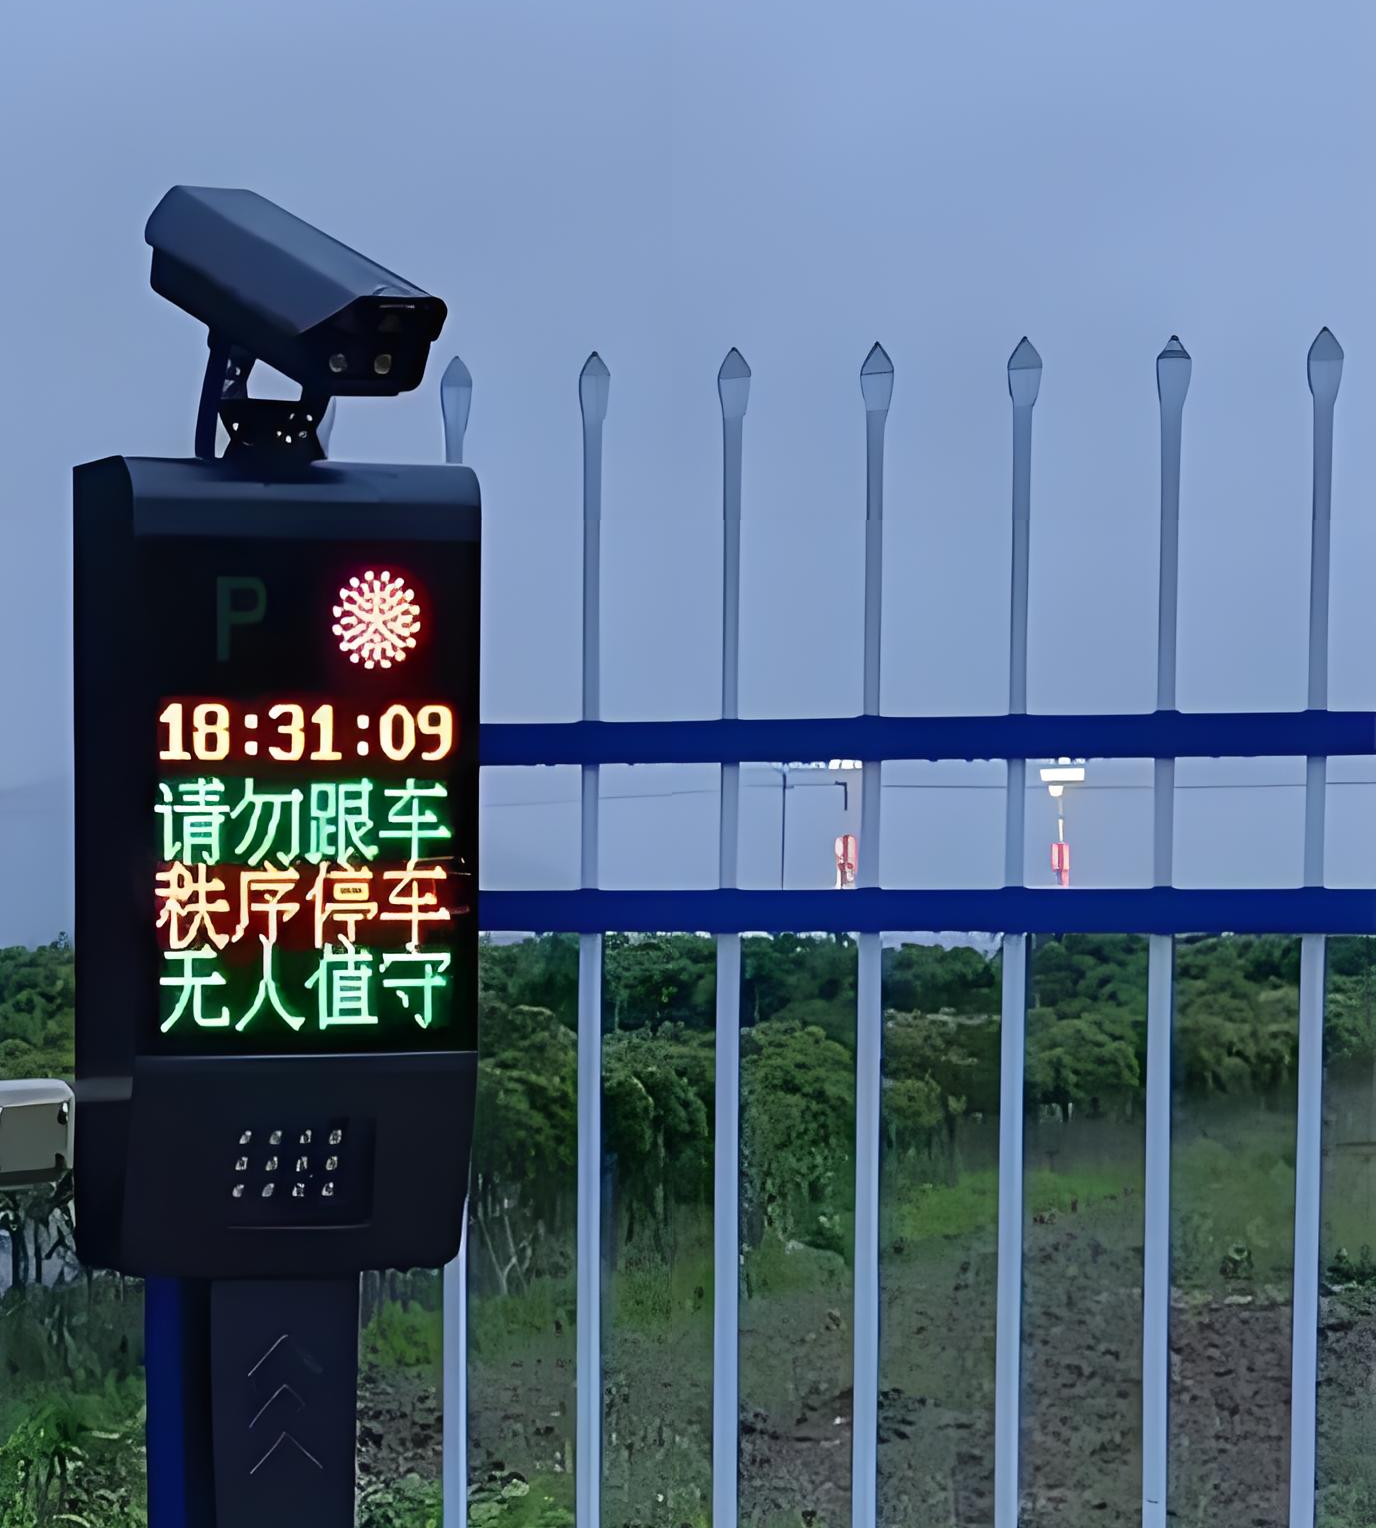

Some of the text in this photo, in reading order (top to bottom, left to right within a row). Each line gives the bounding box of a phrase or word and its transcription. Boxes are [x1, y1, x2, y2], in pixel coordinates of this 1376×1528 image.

[159, 702, 453, 761] 18:31:09
[154, 777, 452, 867] 请勿跟车
[154, 860, 452, 950] 秩序停车
[159, 935, 452, 1033] 无人值守
